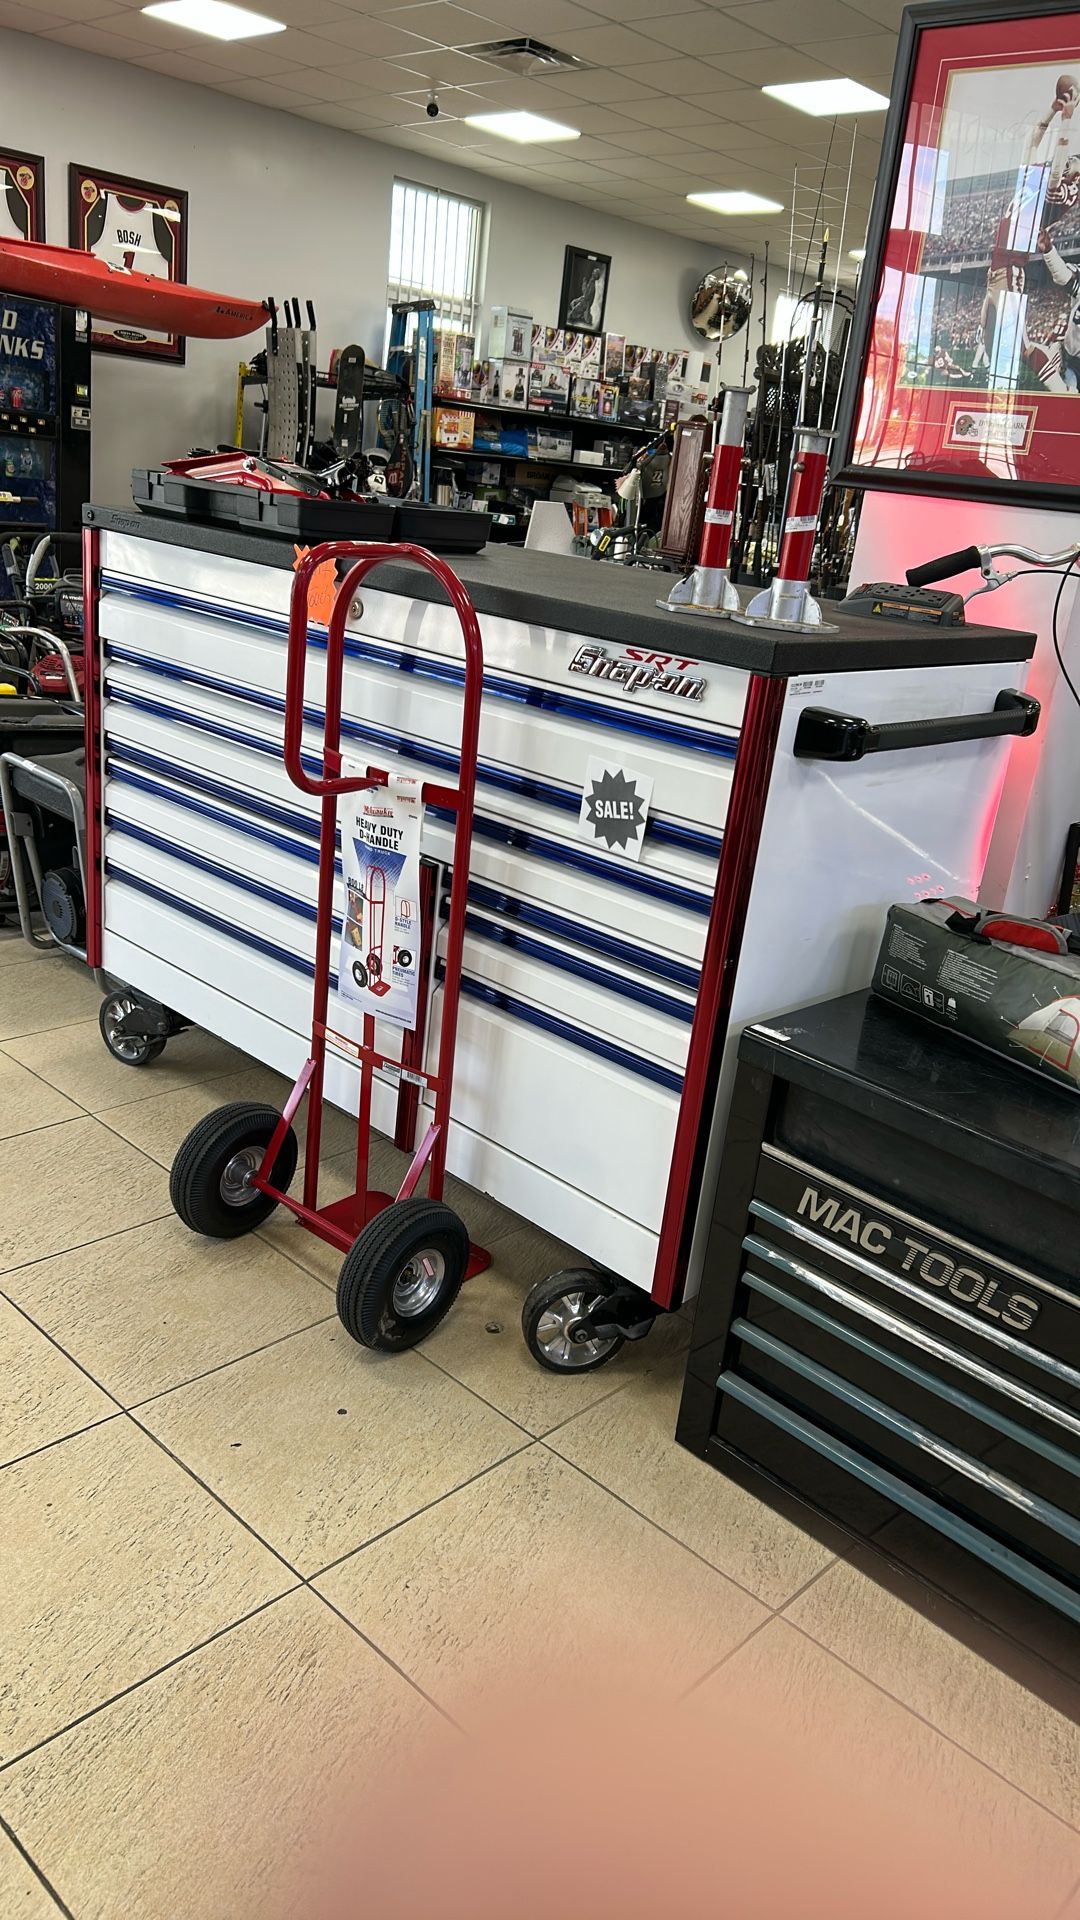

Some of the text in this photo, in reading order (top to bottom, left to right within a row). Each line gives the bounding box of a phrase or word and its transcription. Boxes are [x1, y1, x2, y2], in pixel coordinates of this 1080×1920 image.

[116, 229, 142, 247] BOSH
[122, 250, 136, 270] 1
[618, 648, 700, 672] SRT
[568, 644, 708, 702] Snap-on
[594, 799, 635, 820] SALE!
[355, 816, 404, 841] HEAVY DUTY
[359, 829, 399, 851] D-HANDLE
[797, 1187, 1040, 1331] MAC TOOLS
